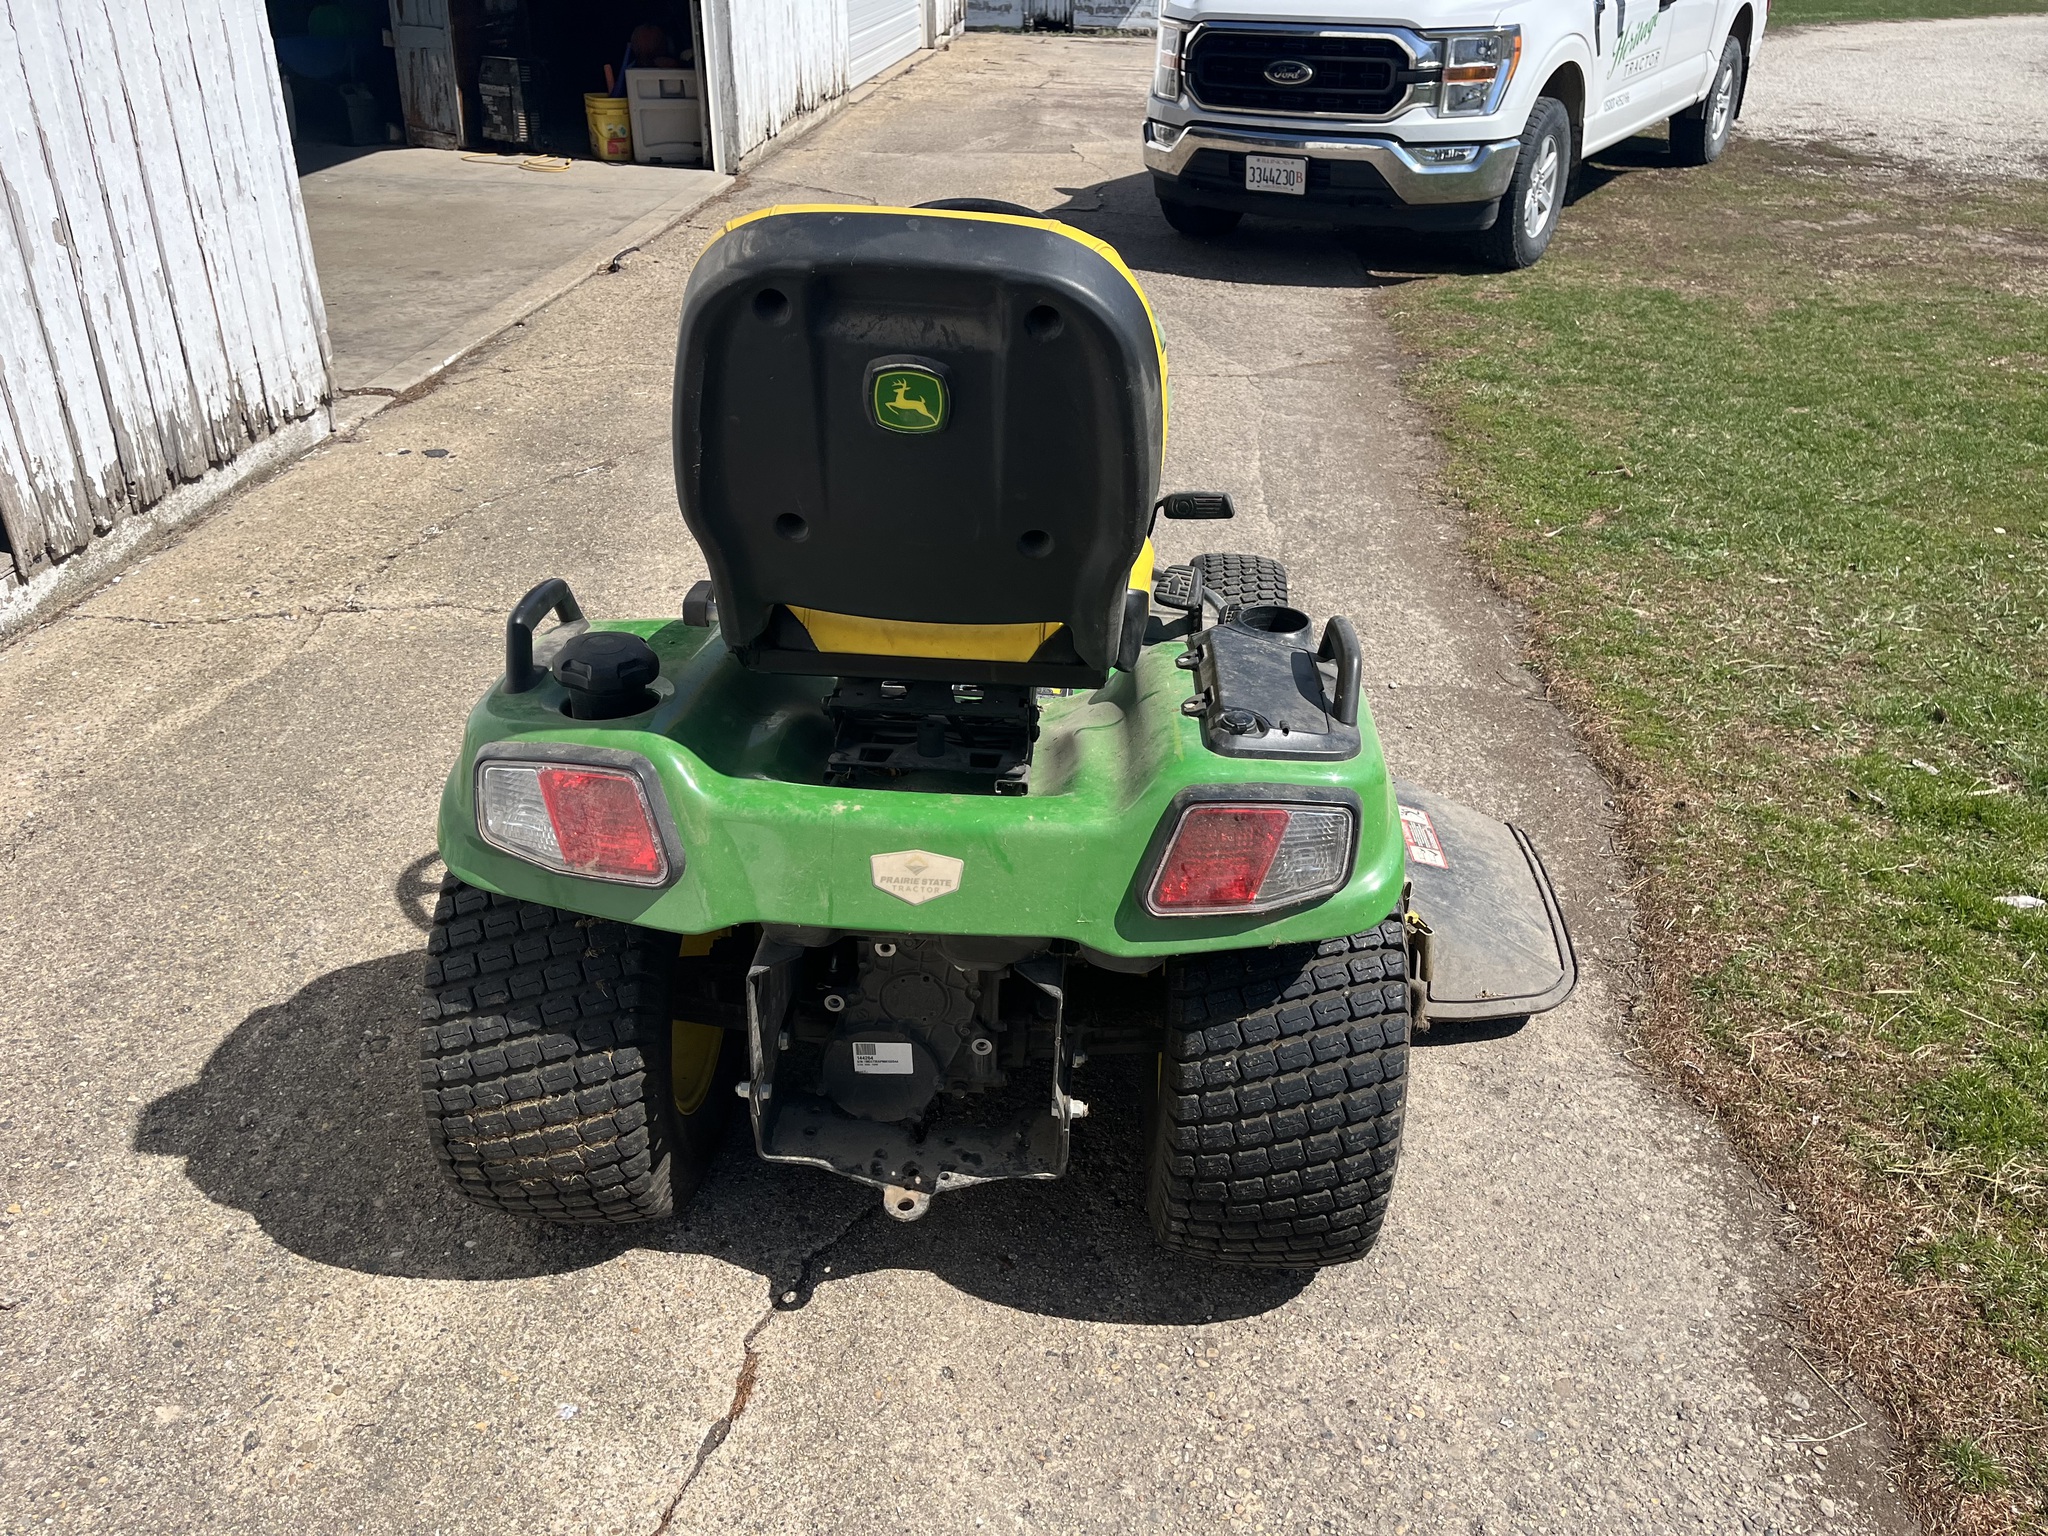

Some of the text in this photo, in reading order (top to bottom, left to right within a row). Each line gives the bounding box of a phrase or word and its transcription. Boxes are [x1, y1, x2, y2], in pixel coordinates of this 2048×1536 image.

[1606, 12, 1660, 81] Heritage
[1623, 50, 1660, 77] TRACTOR
[1273, 65, 1301, 79] Ford
[880, 876, 952, 887] PRAIRIE STATE
[892, 884, 940, 894] TRACTOR
